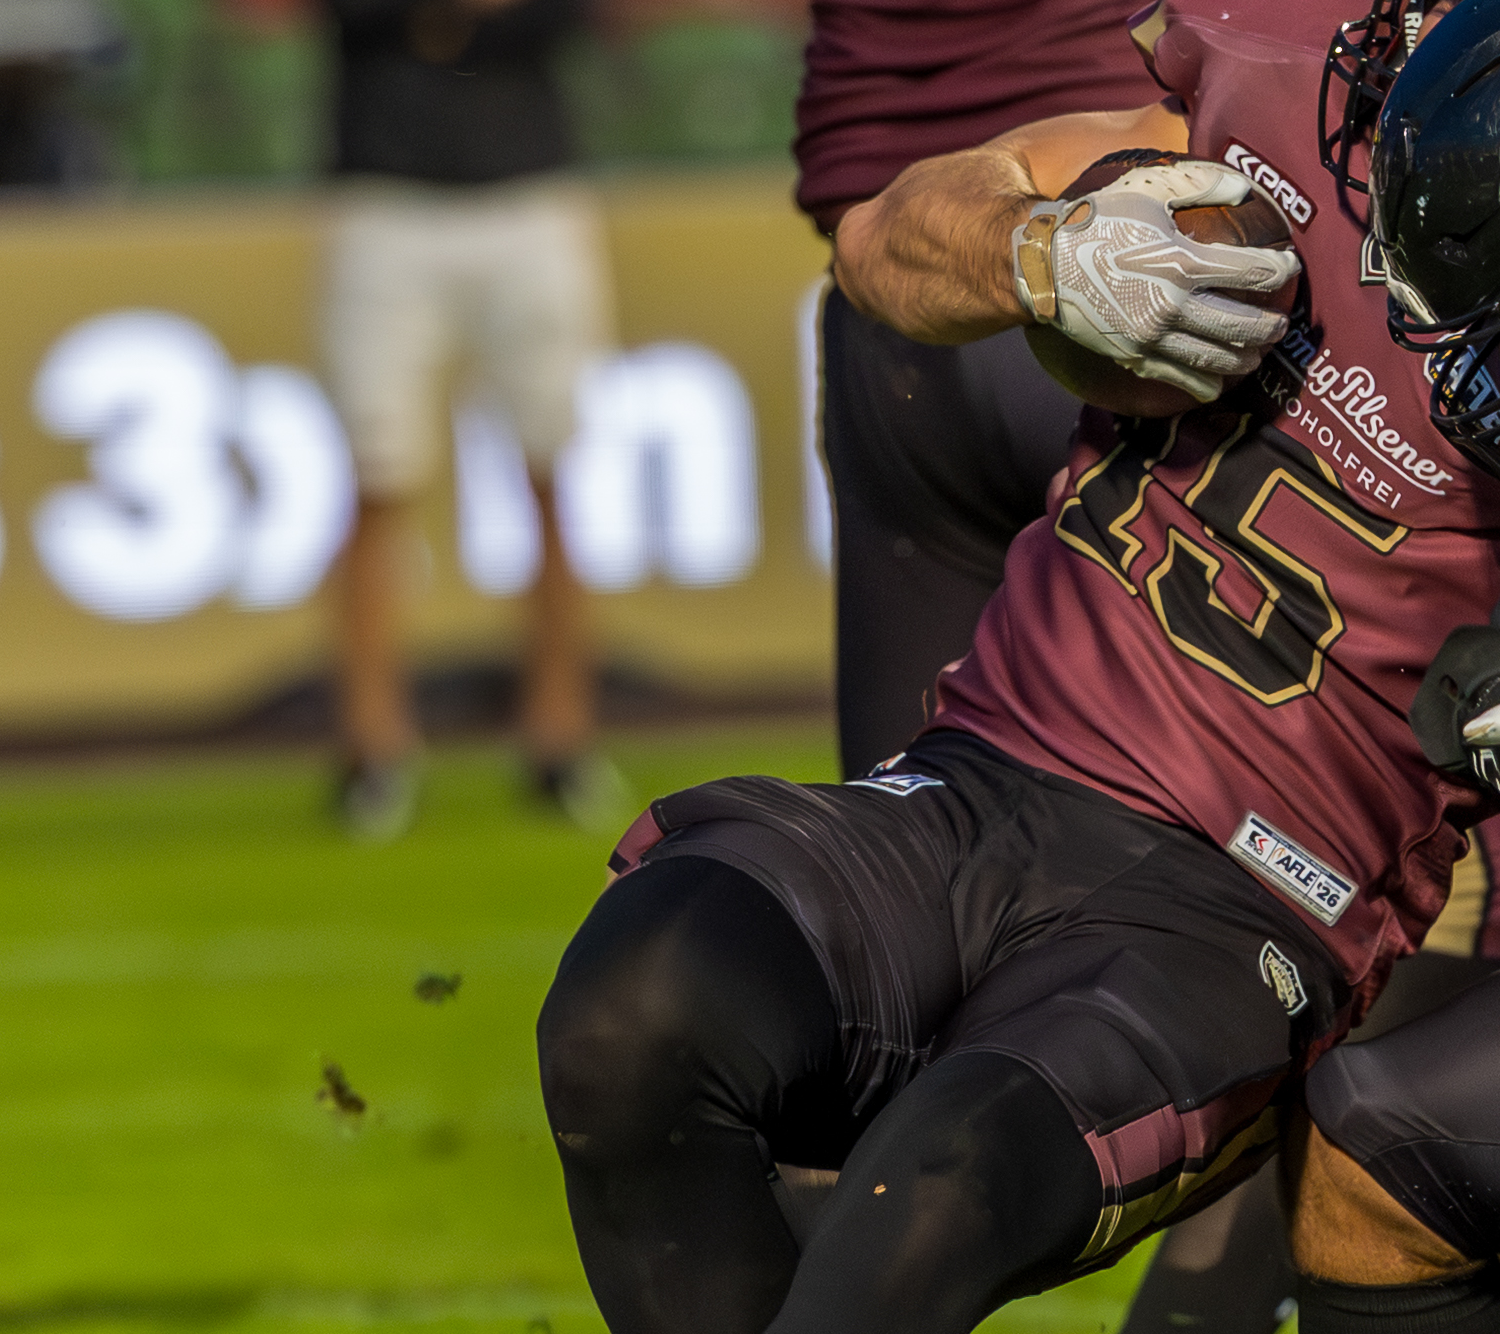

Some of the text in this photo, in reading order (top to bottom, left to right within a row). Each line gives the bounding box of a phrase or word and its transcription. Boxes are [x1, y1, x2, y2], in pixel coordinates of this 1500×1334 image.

[1054, 419, 1412, 708] 15
[1274, 853, 1318, 888] AFLE
[1316, 880, 1342, 909] '26
